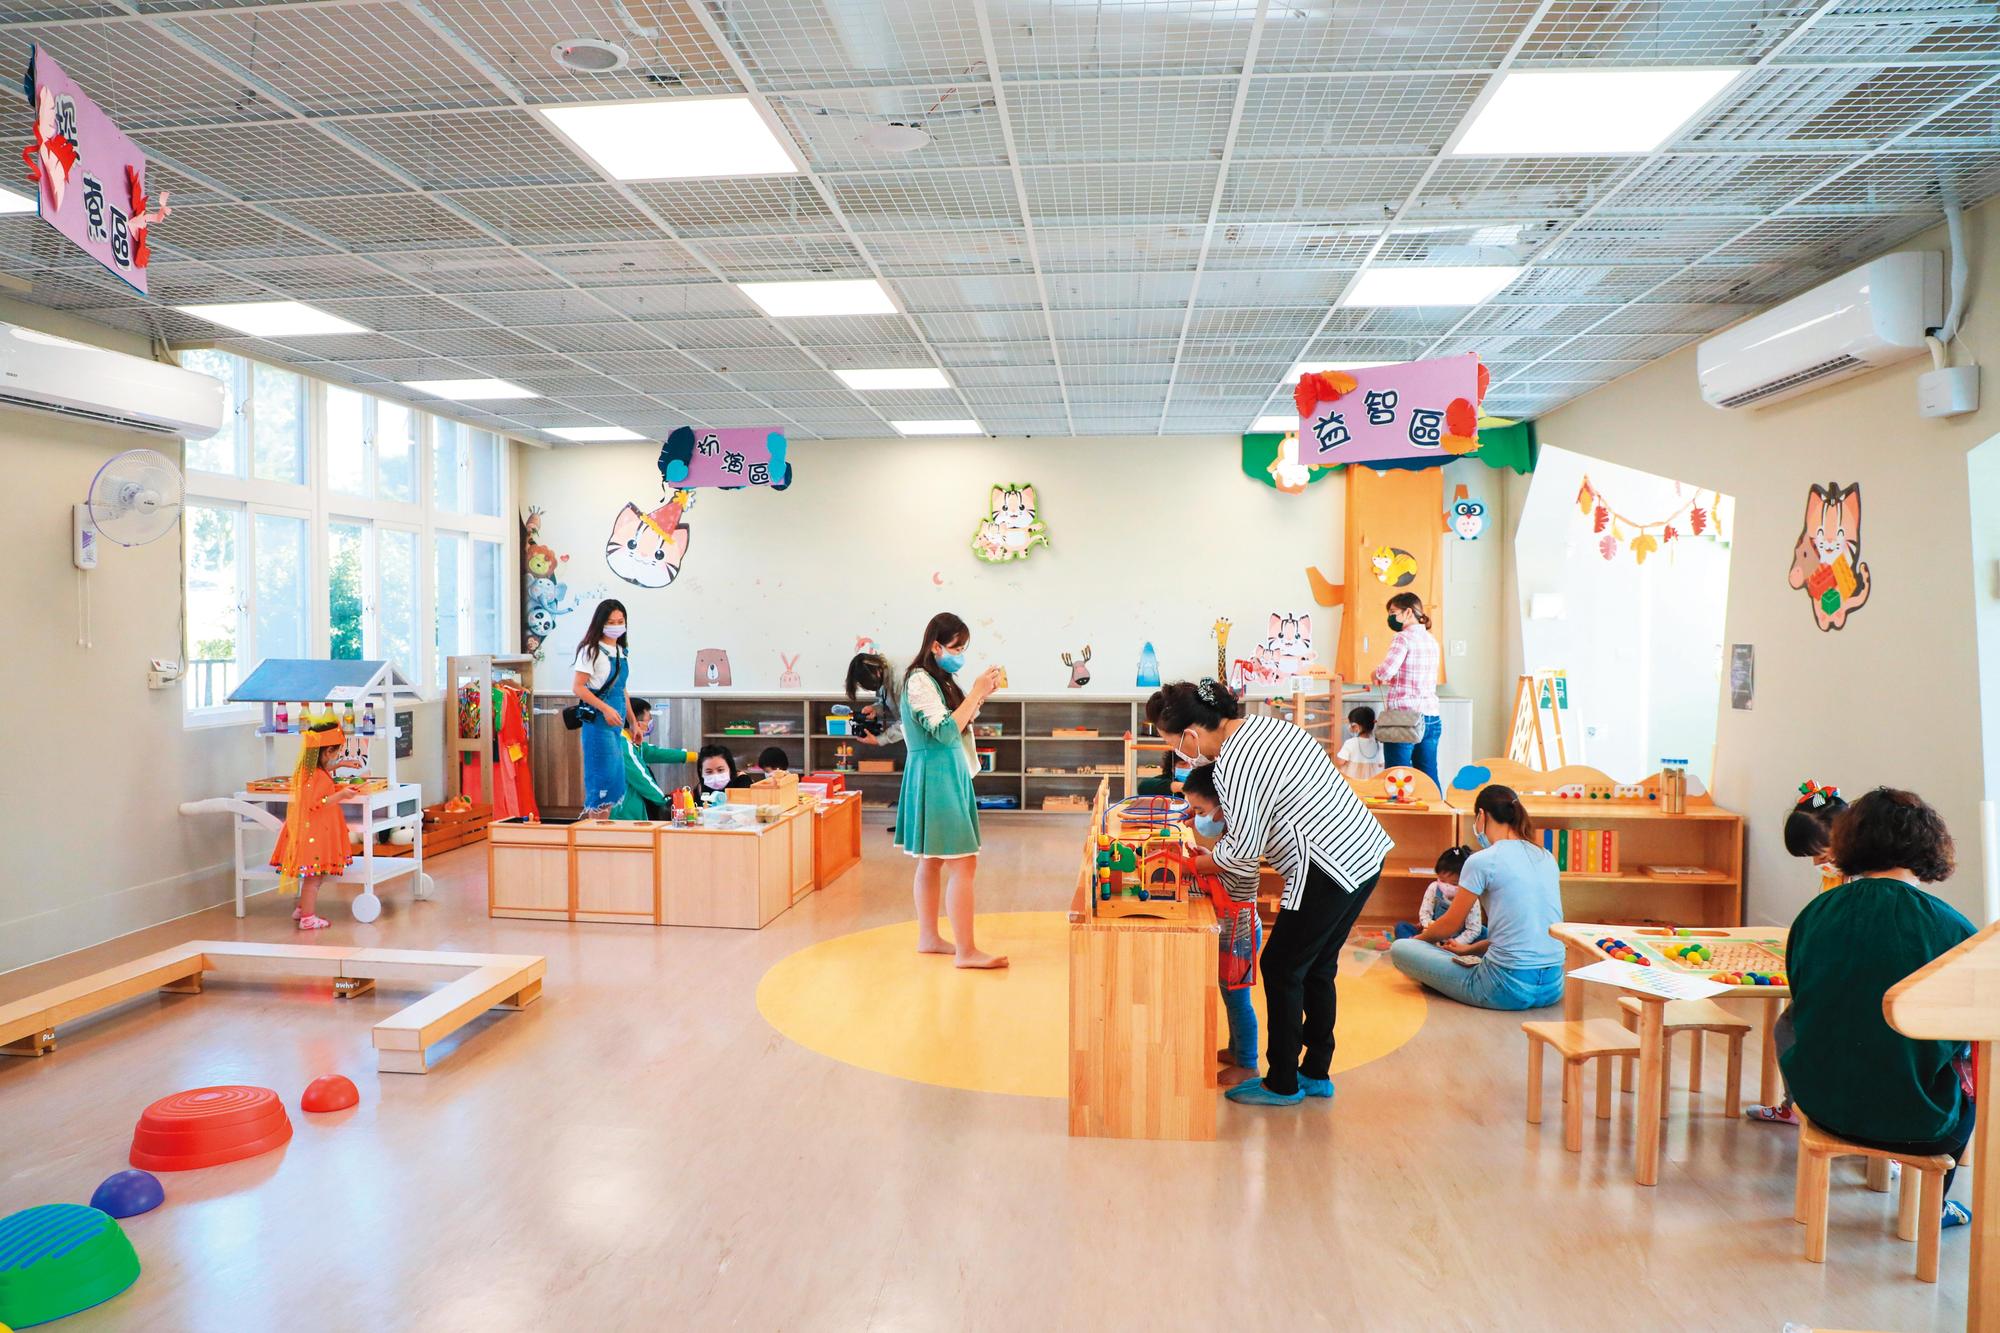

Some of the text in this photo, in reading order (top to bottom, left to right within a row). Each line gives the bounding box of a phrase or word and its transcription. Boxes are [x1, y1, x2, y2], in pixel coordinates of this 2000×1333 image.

[1313, 390, 1445, 452] 益智區
[697, 434, 770, 485] 扮演區
